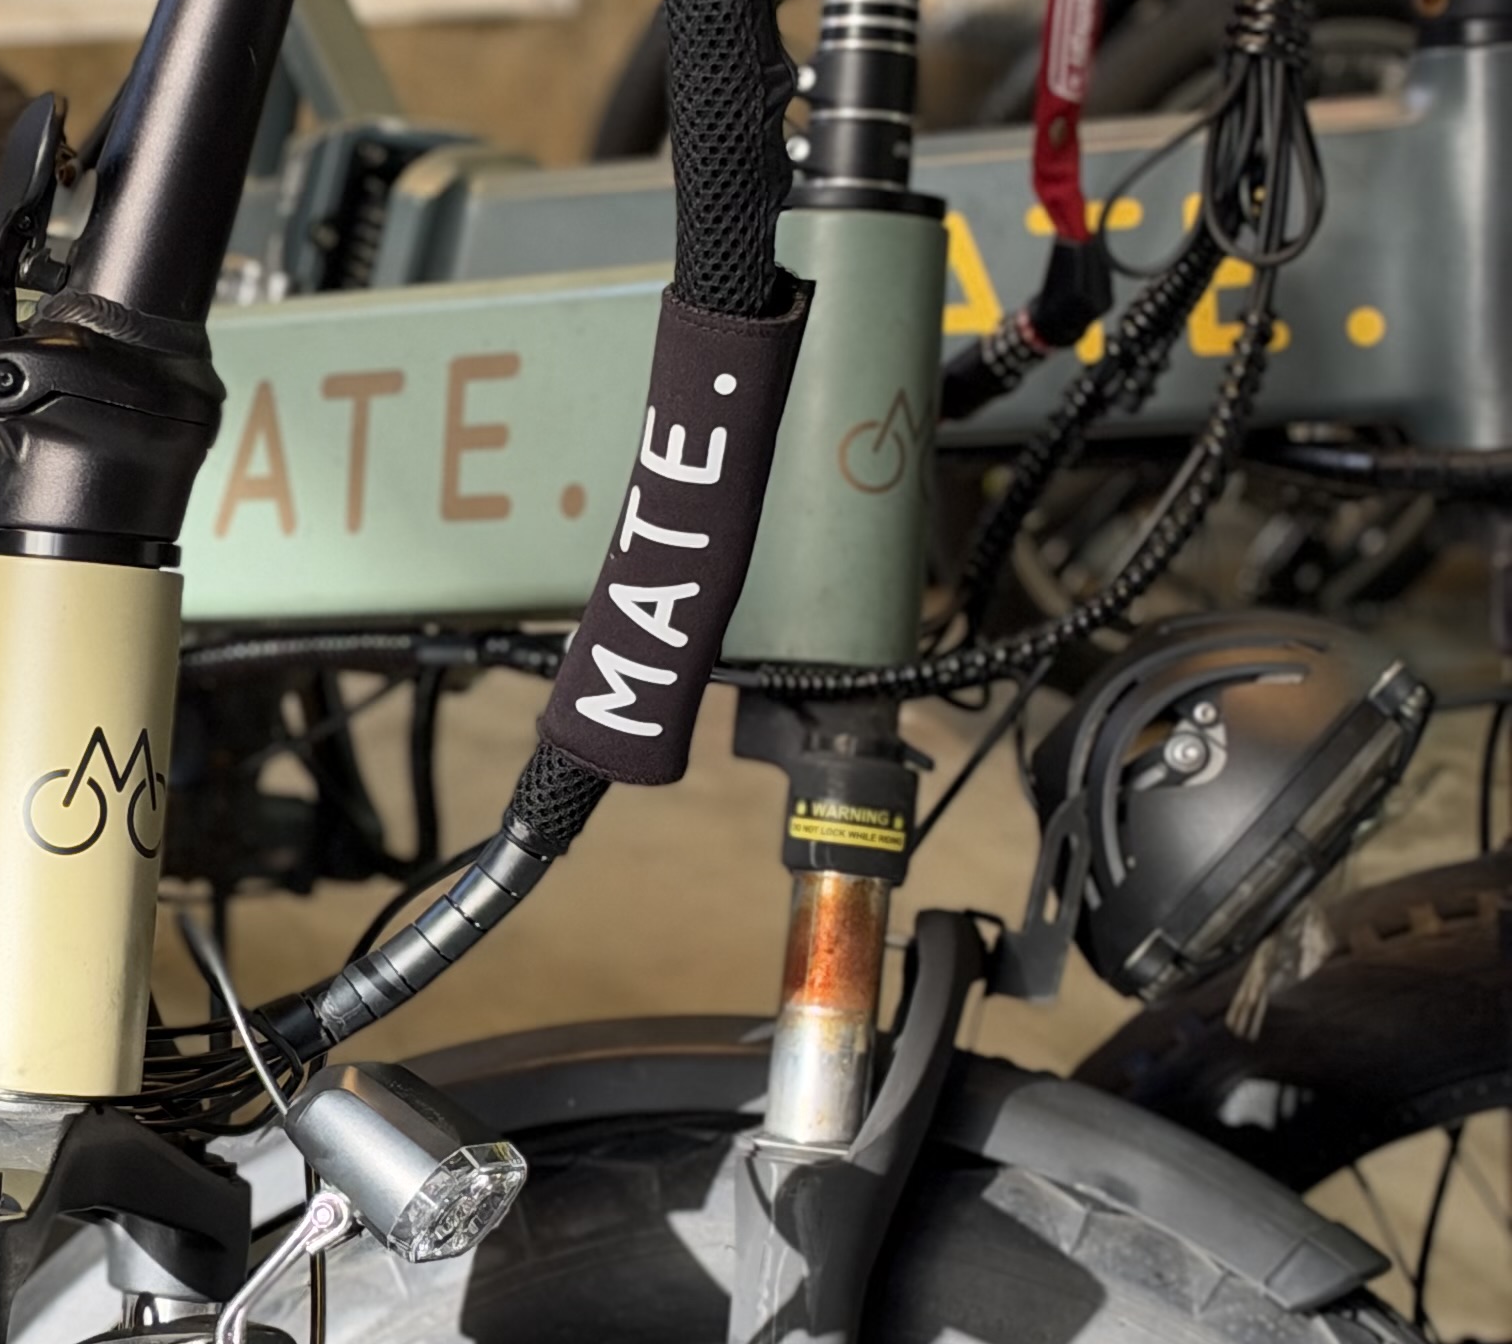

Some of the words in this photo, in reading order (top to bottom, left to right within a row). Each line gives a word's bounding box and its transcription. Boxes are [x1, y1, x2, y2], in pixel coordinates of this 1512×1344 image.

[213, 351, 588, 540] ATE.
[574, 372, 738, 738] MATE.
[811, 800, 890, 826] WARNING
[820, 827, 846, 838] LOCK
[848, 830, 878, 843] WHILE
